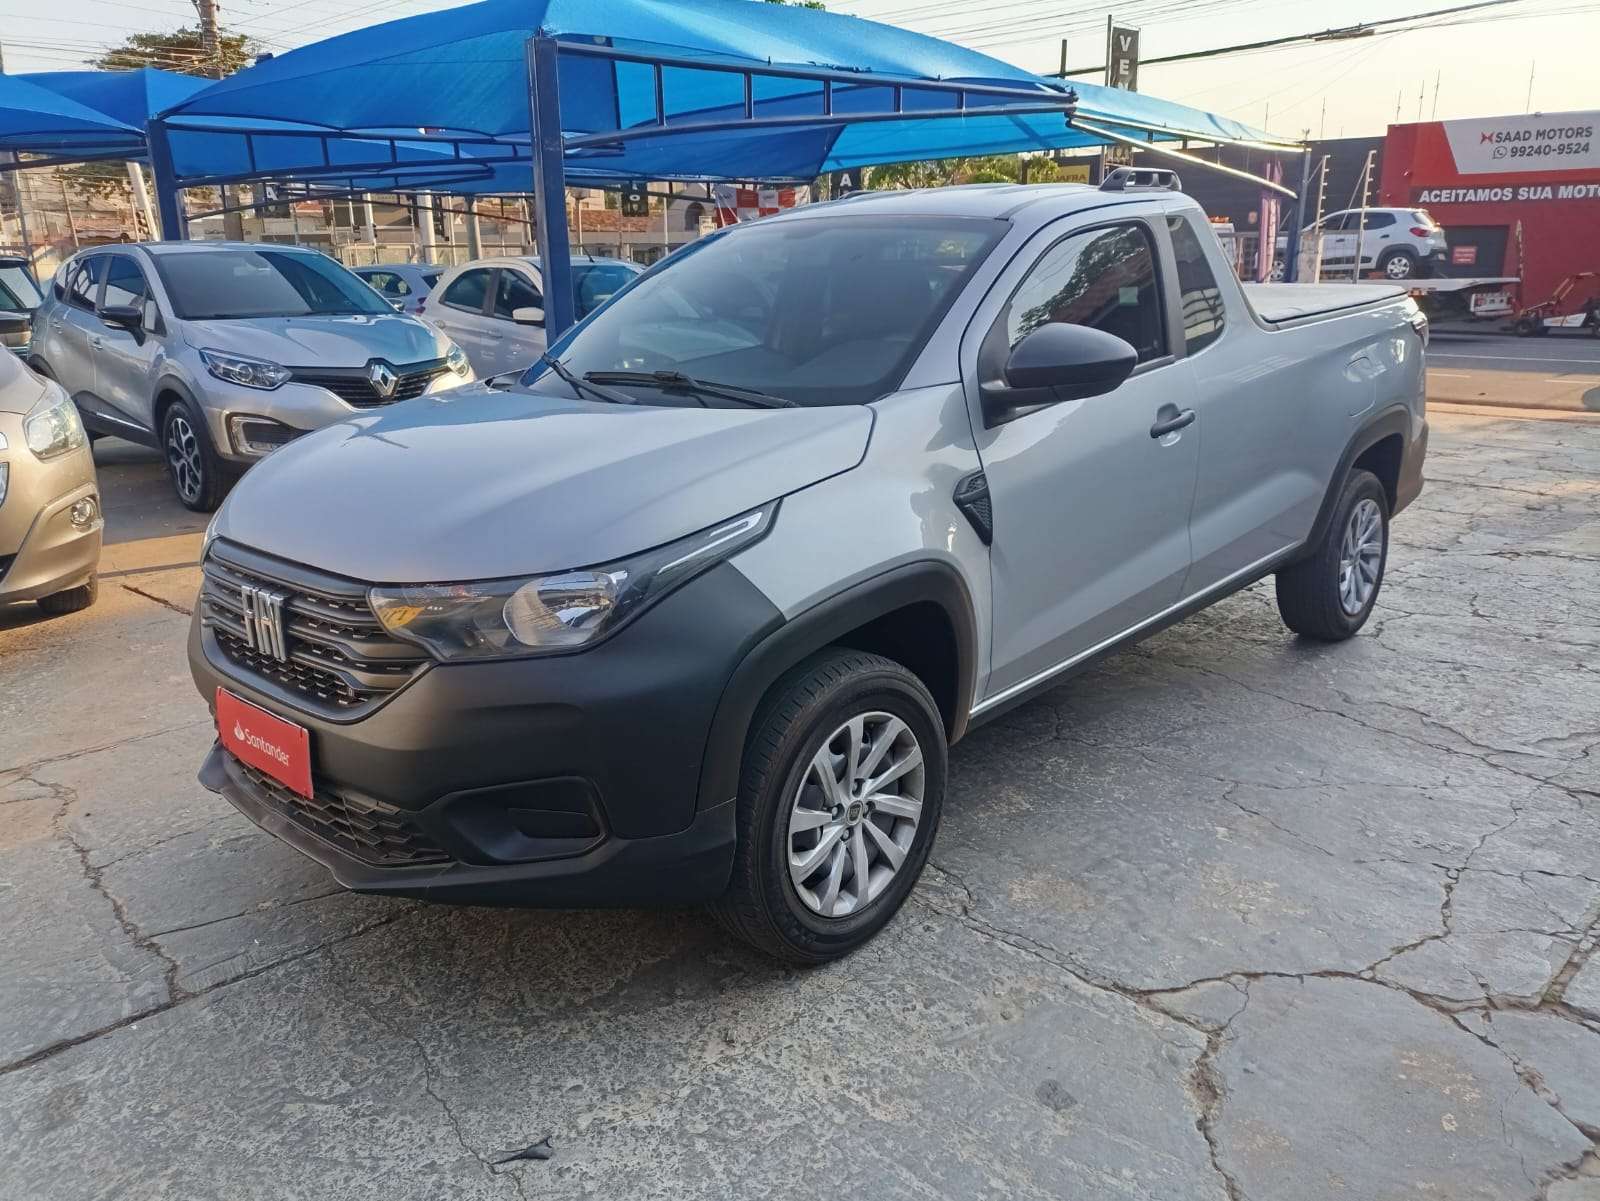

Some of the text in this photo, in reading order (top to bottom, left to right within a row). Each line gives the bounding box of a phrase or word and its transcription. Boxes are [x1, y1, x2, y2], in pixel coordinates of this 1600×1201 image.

[1495, 126, 1593, 143] SAAD MOTORS
[1510, 142, 1590, 158] 99240-9524
[1419, 183, 1600, 202] ACEITAMOS SUA MOT
[244, 728, 291, 767] Santander
